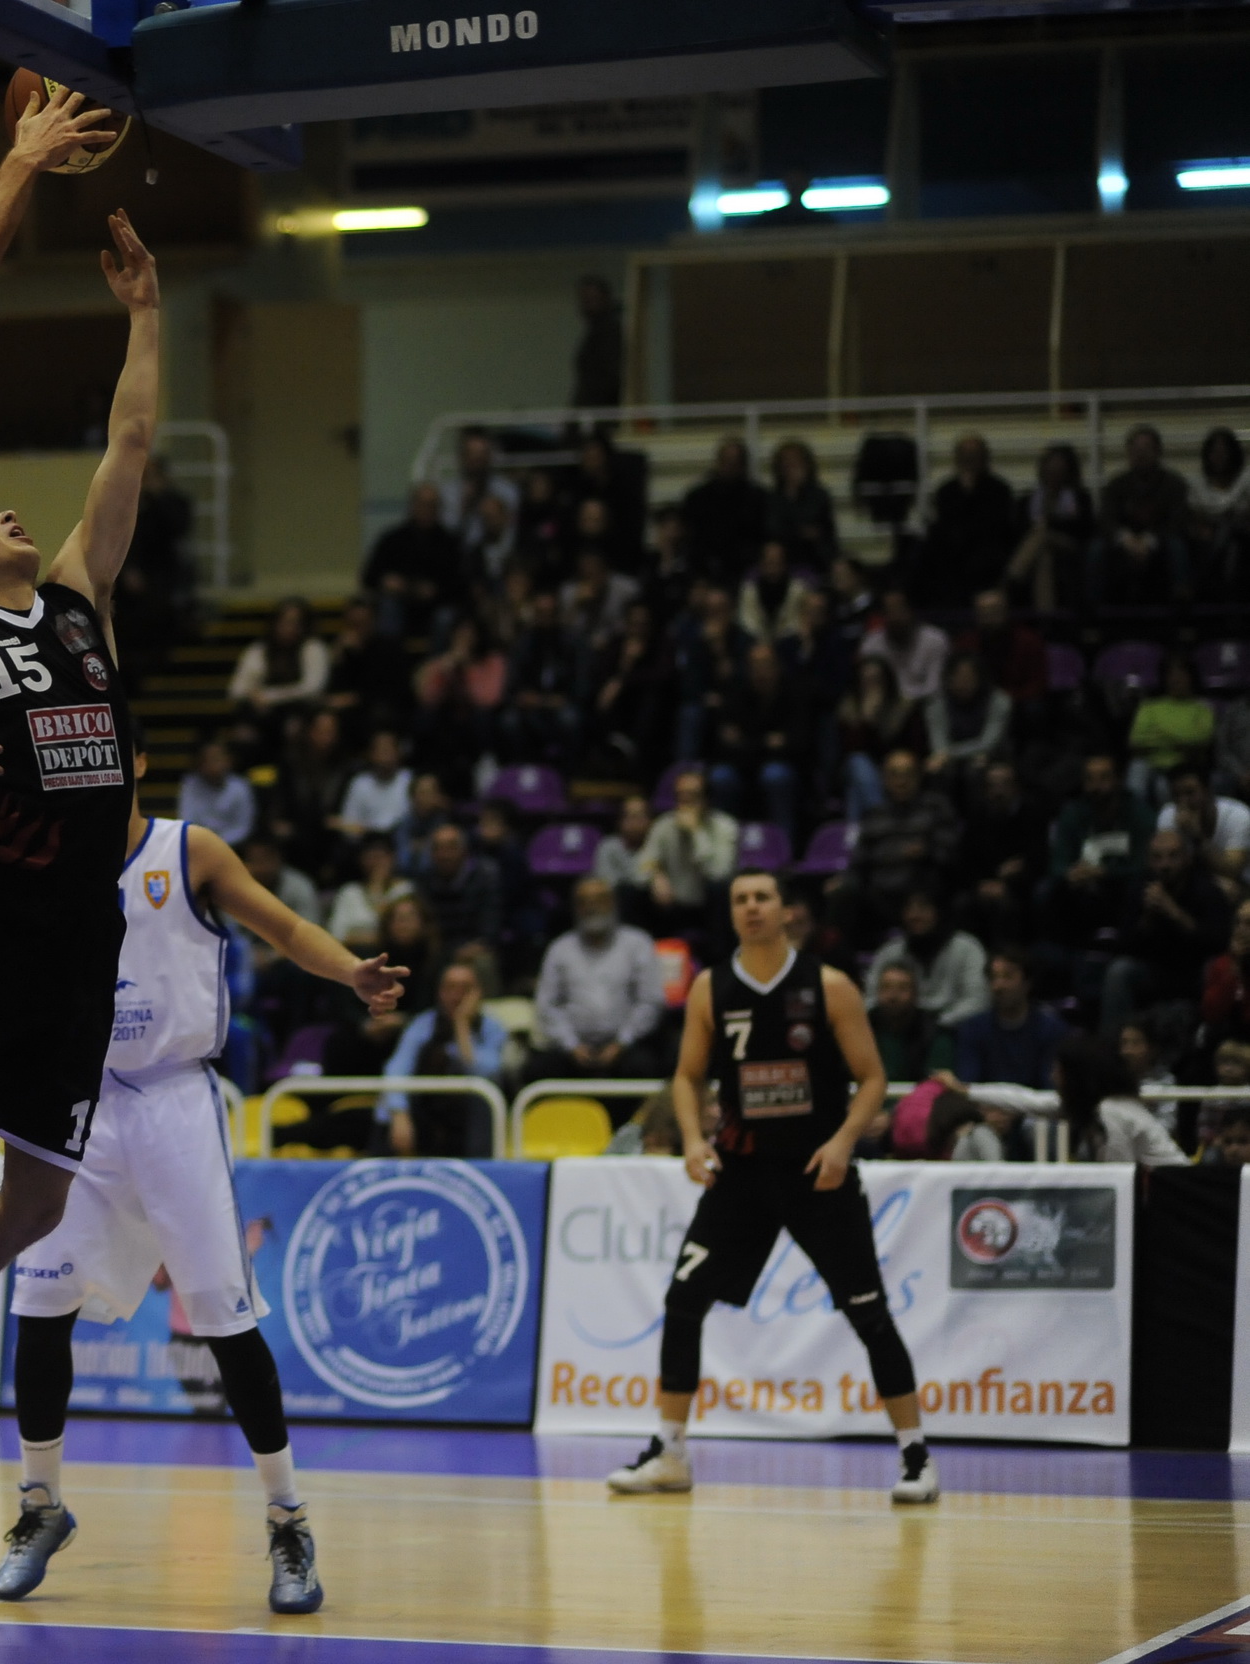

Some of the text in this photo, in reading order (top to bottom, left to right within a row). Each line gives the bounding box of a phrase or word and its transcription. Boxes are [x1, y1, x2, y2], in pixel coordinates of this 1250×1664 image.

[390, 10, 538, 53] MONDO
[33, 711, 112, 738] BRICO
[40, 736, 116, 770] DEPÔT
[113, 1024, 147, 1042] 2017
[724, 1020, 753, 1061] 7
[561, 1206, 690, 1264] Club
[675, 1240, 710, 1283] 7
[552, 1363, 1115, 1420] Recopensa tu onfianza
